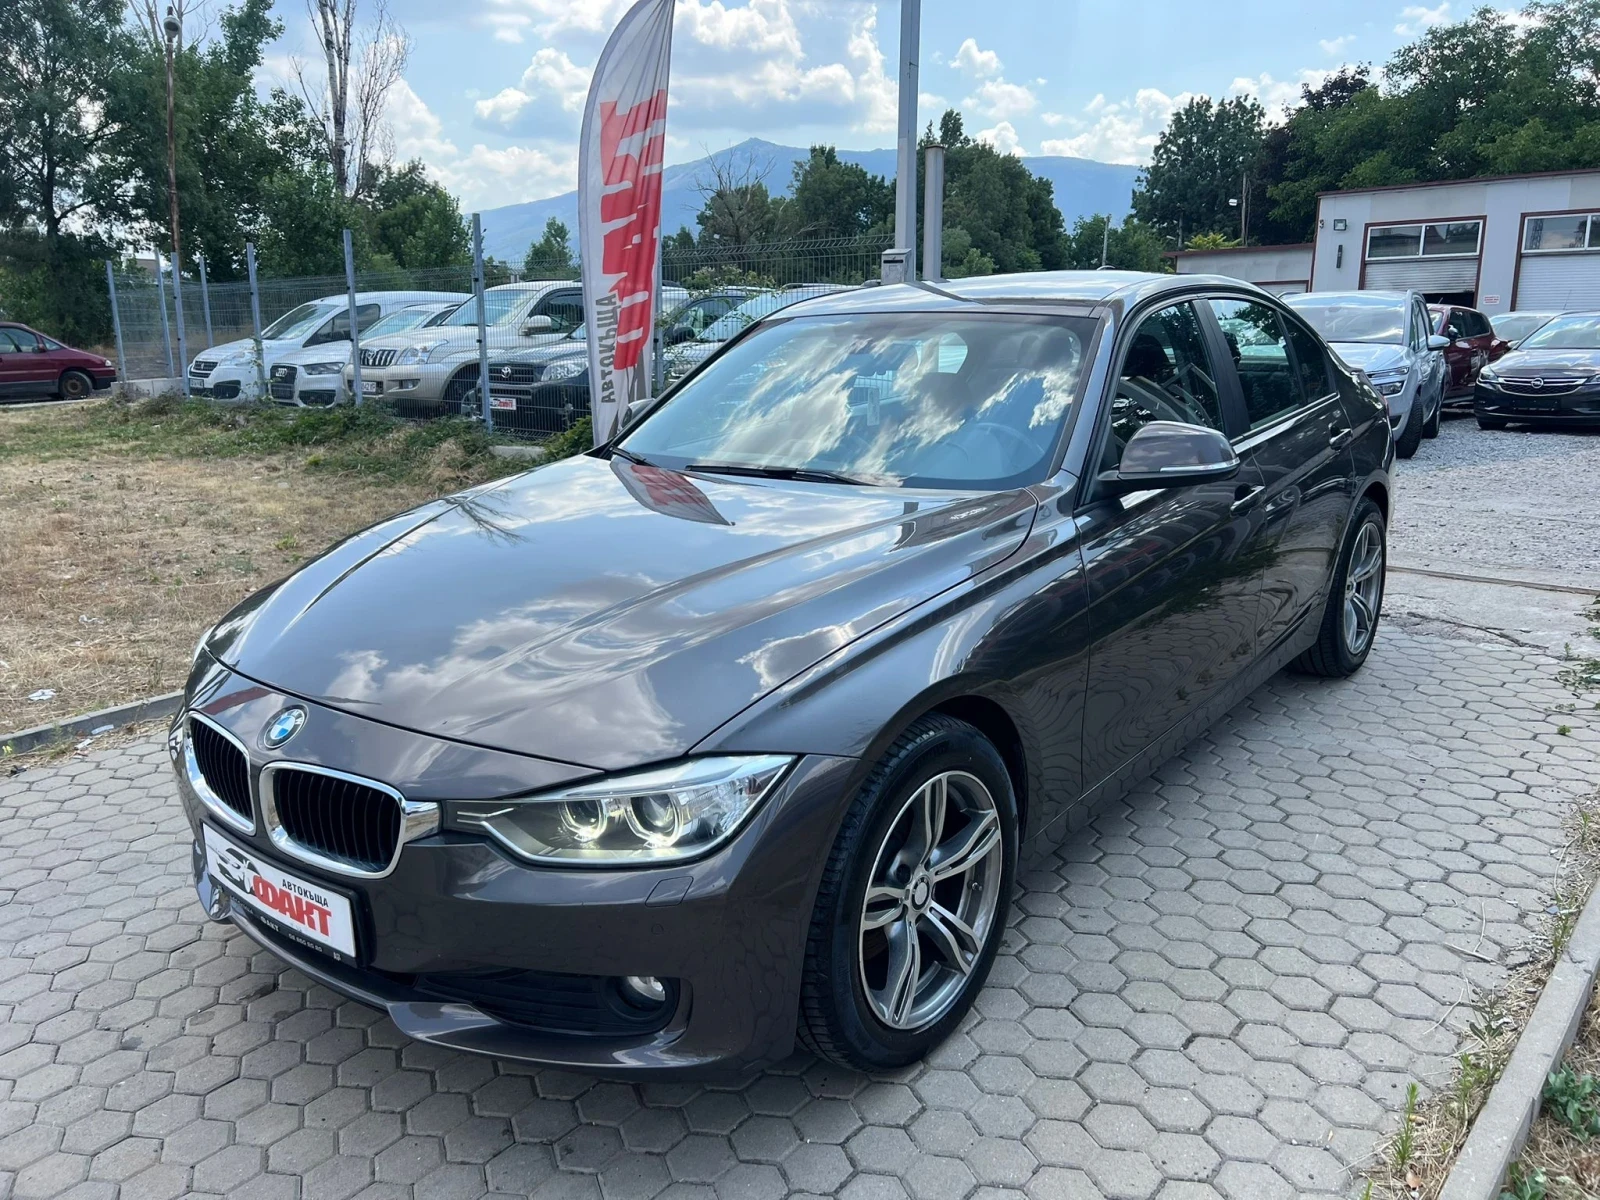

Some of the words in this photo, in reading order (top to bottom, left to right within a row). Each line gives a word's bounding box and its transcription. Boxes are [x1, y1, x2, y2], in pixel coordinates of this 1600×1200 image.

[596, 293, 621, 403] АВТОКЪЩА
[253, 875, 331, 937] ФАКТ
[282, 879, 329, 907] АВТОКЪЩА
